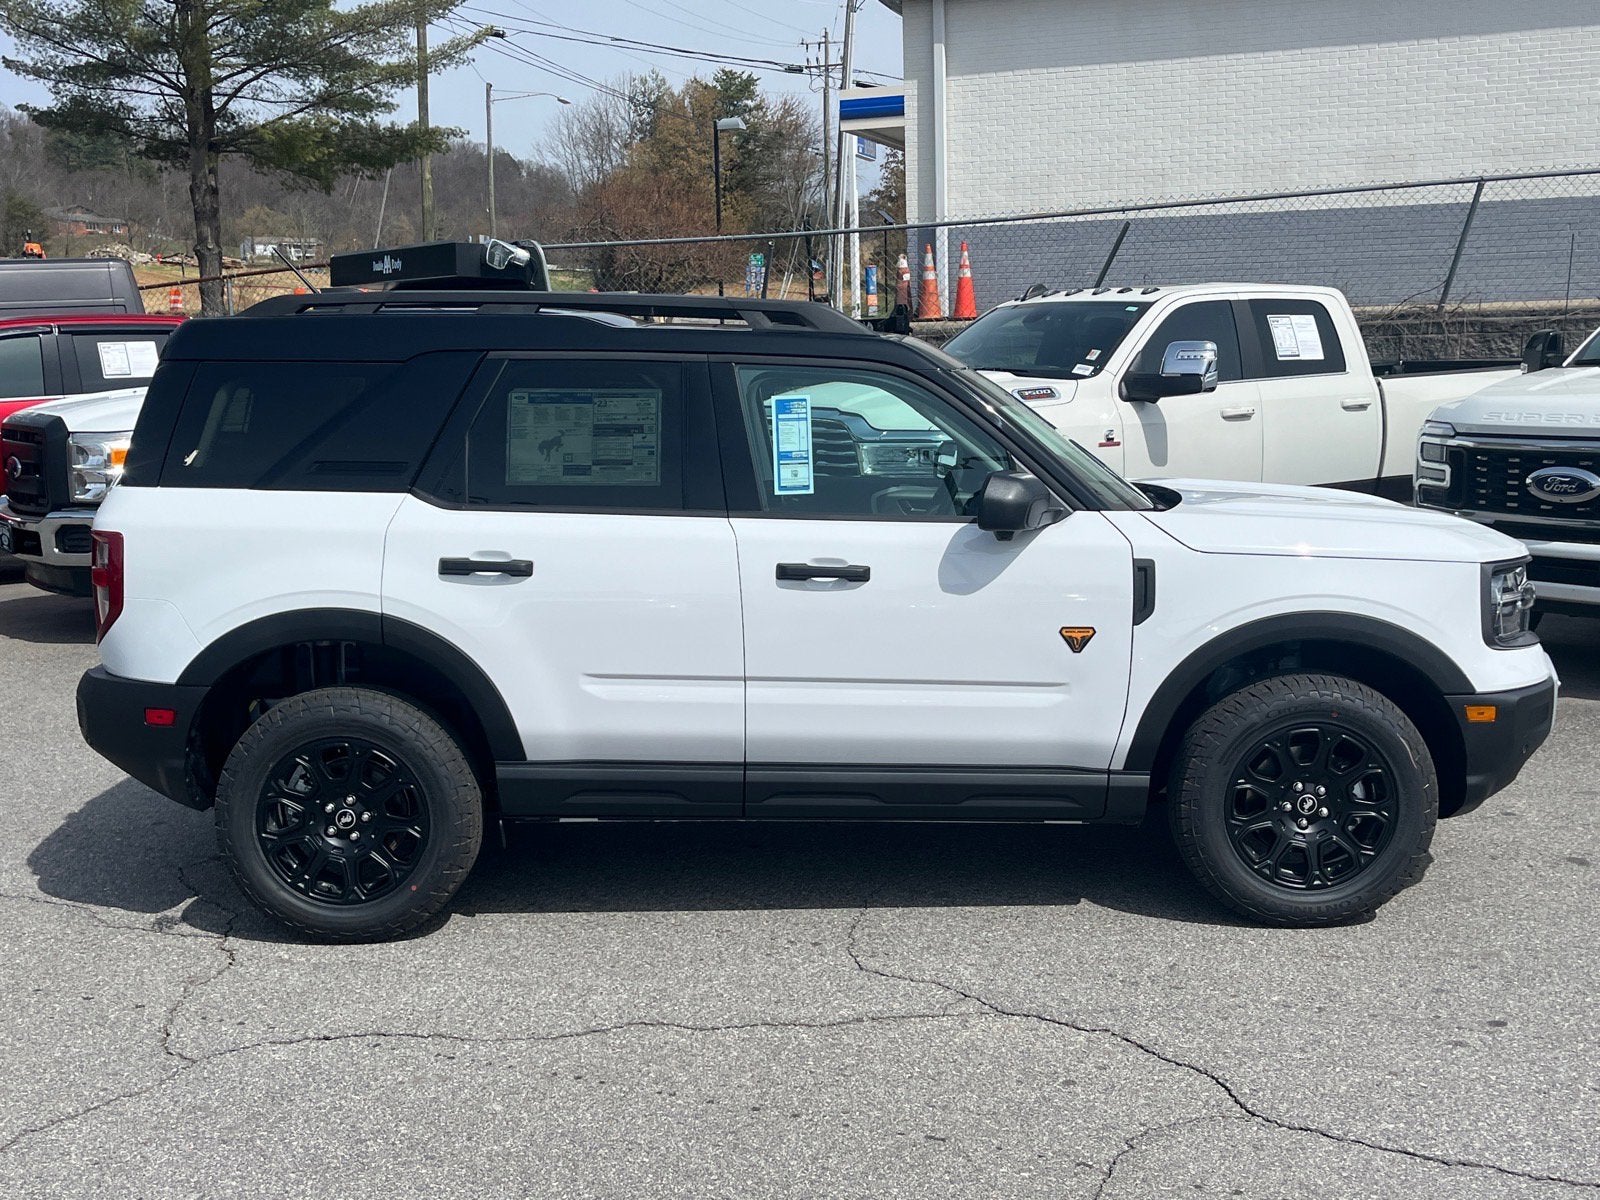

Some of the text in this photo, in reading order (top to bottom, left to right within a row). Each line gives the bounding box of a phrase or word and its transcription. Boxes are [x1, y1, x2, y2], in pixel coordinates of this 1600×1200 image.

[1020, 388, 1051, 396] 3500
[1480, 411, 1585, 425] SUPER
[1543, 476, 1578, 493] Ford
